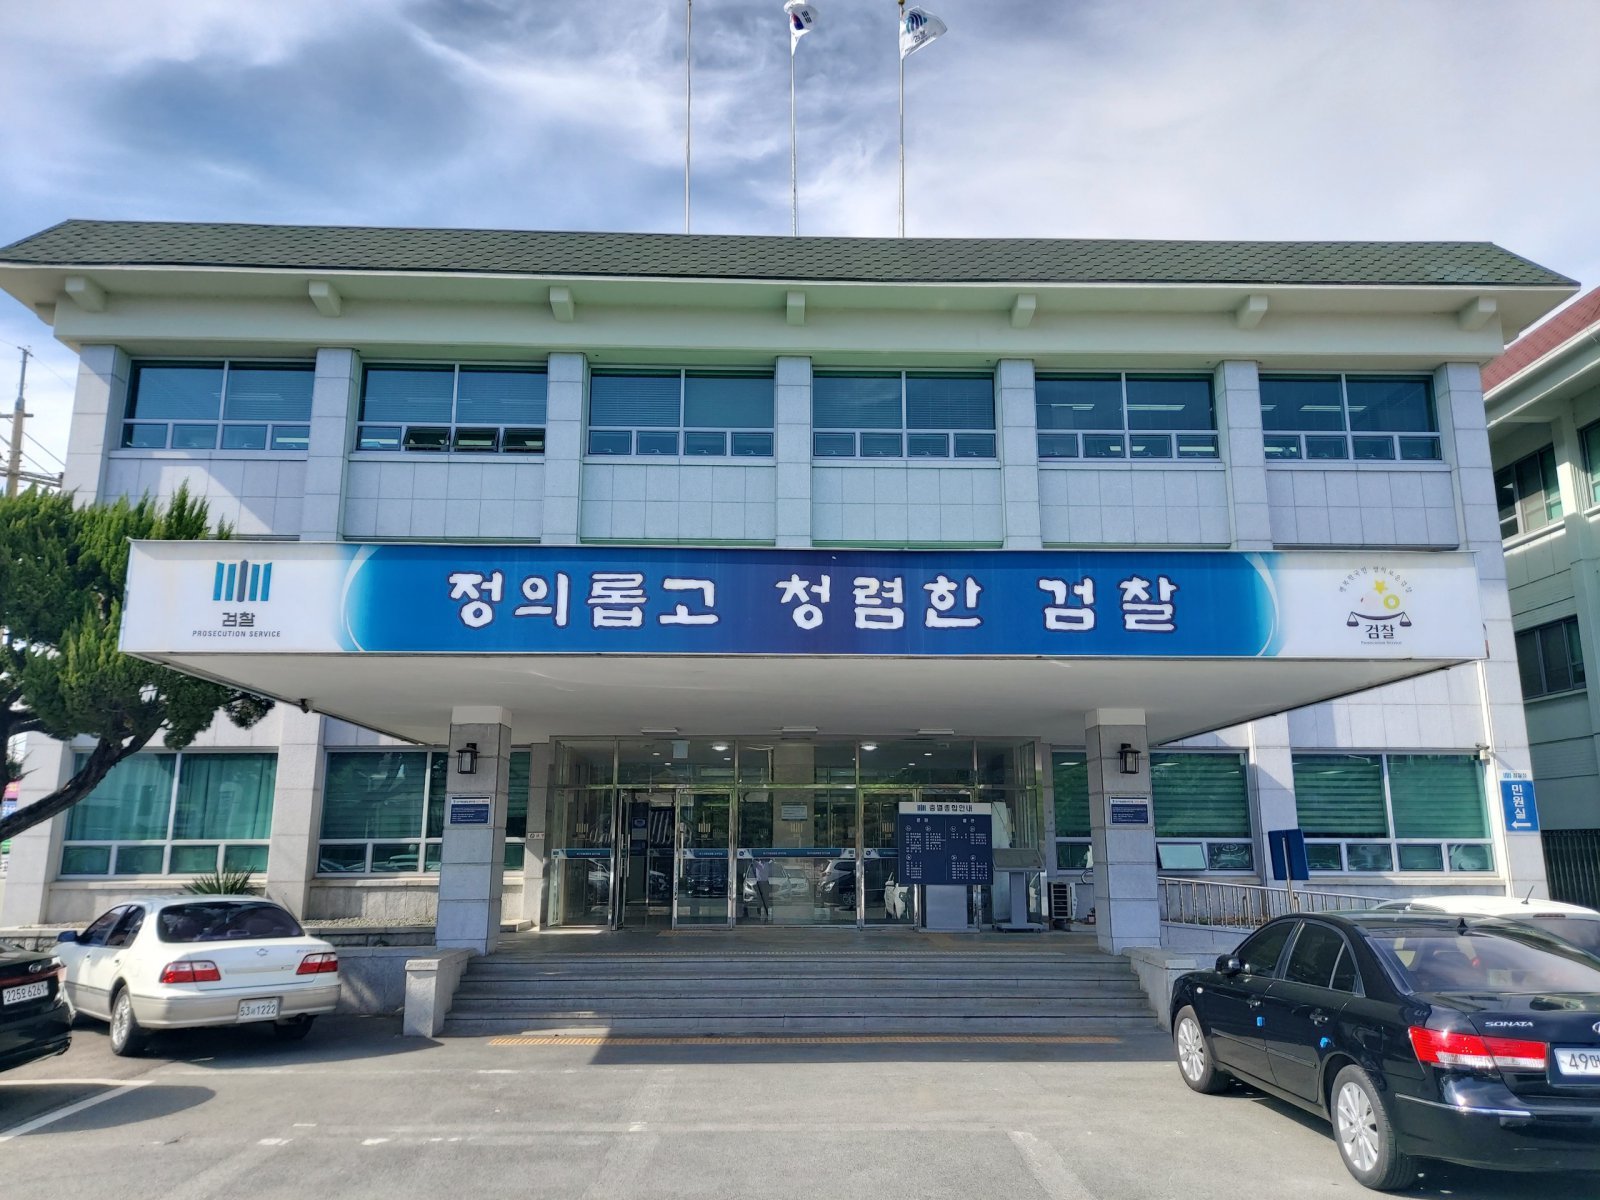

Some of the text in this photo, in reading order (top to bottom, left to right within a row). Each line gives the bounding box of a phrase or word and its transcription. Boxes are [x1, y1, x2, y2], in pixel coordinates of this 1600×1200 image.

[449, 571, 1177, 631] 정의롭고 청렴한 검찰
[222, 611, 255, 627] 검찰
[1365, 624, 1395, 639] 검찰
[1511, 784, 1526, 819] 민원실
